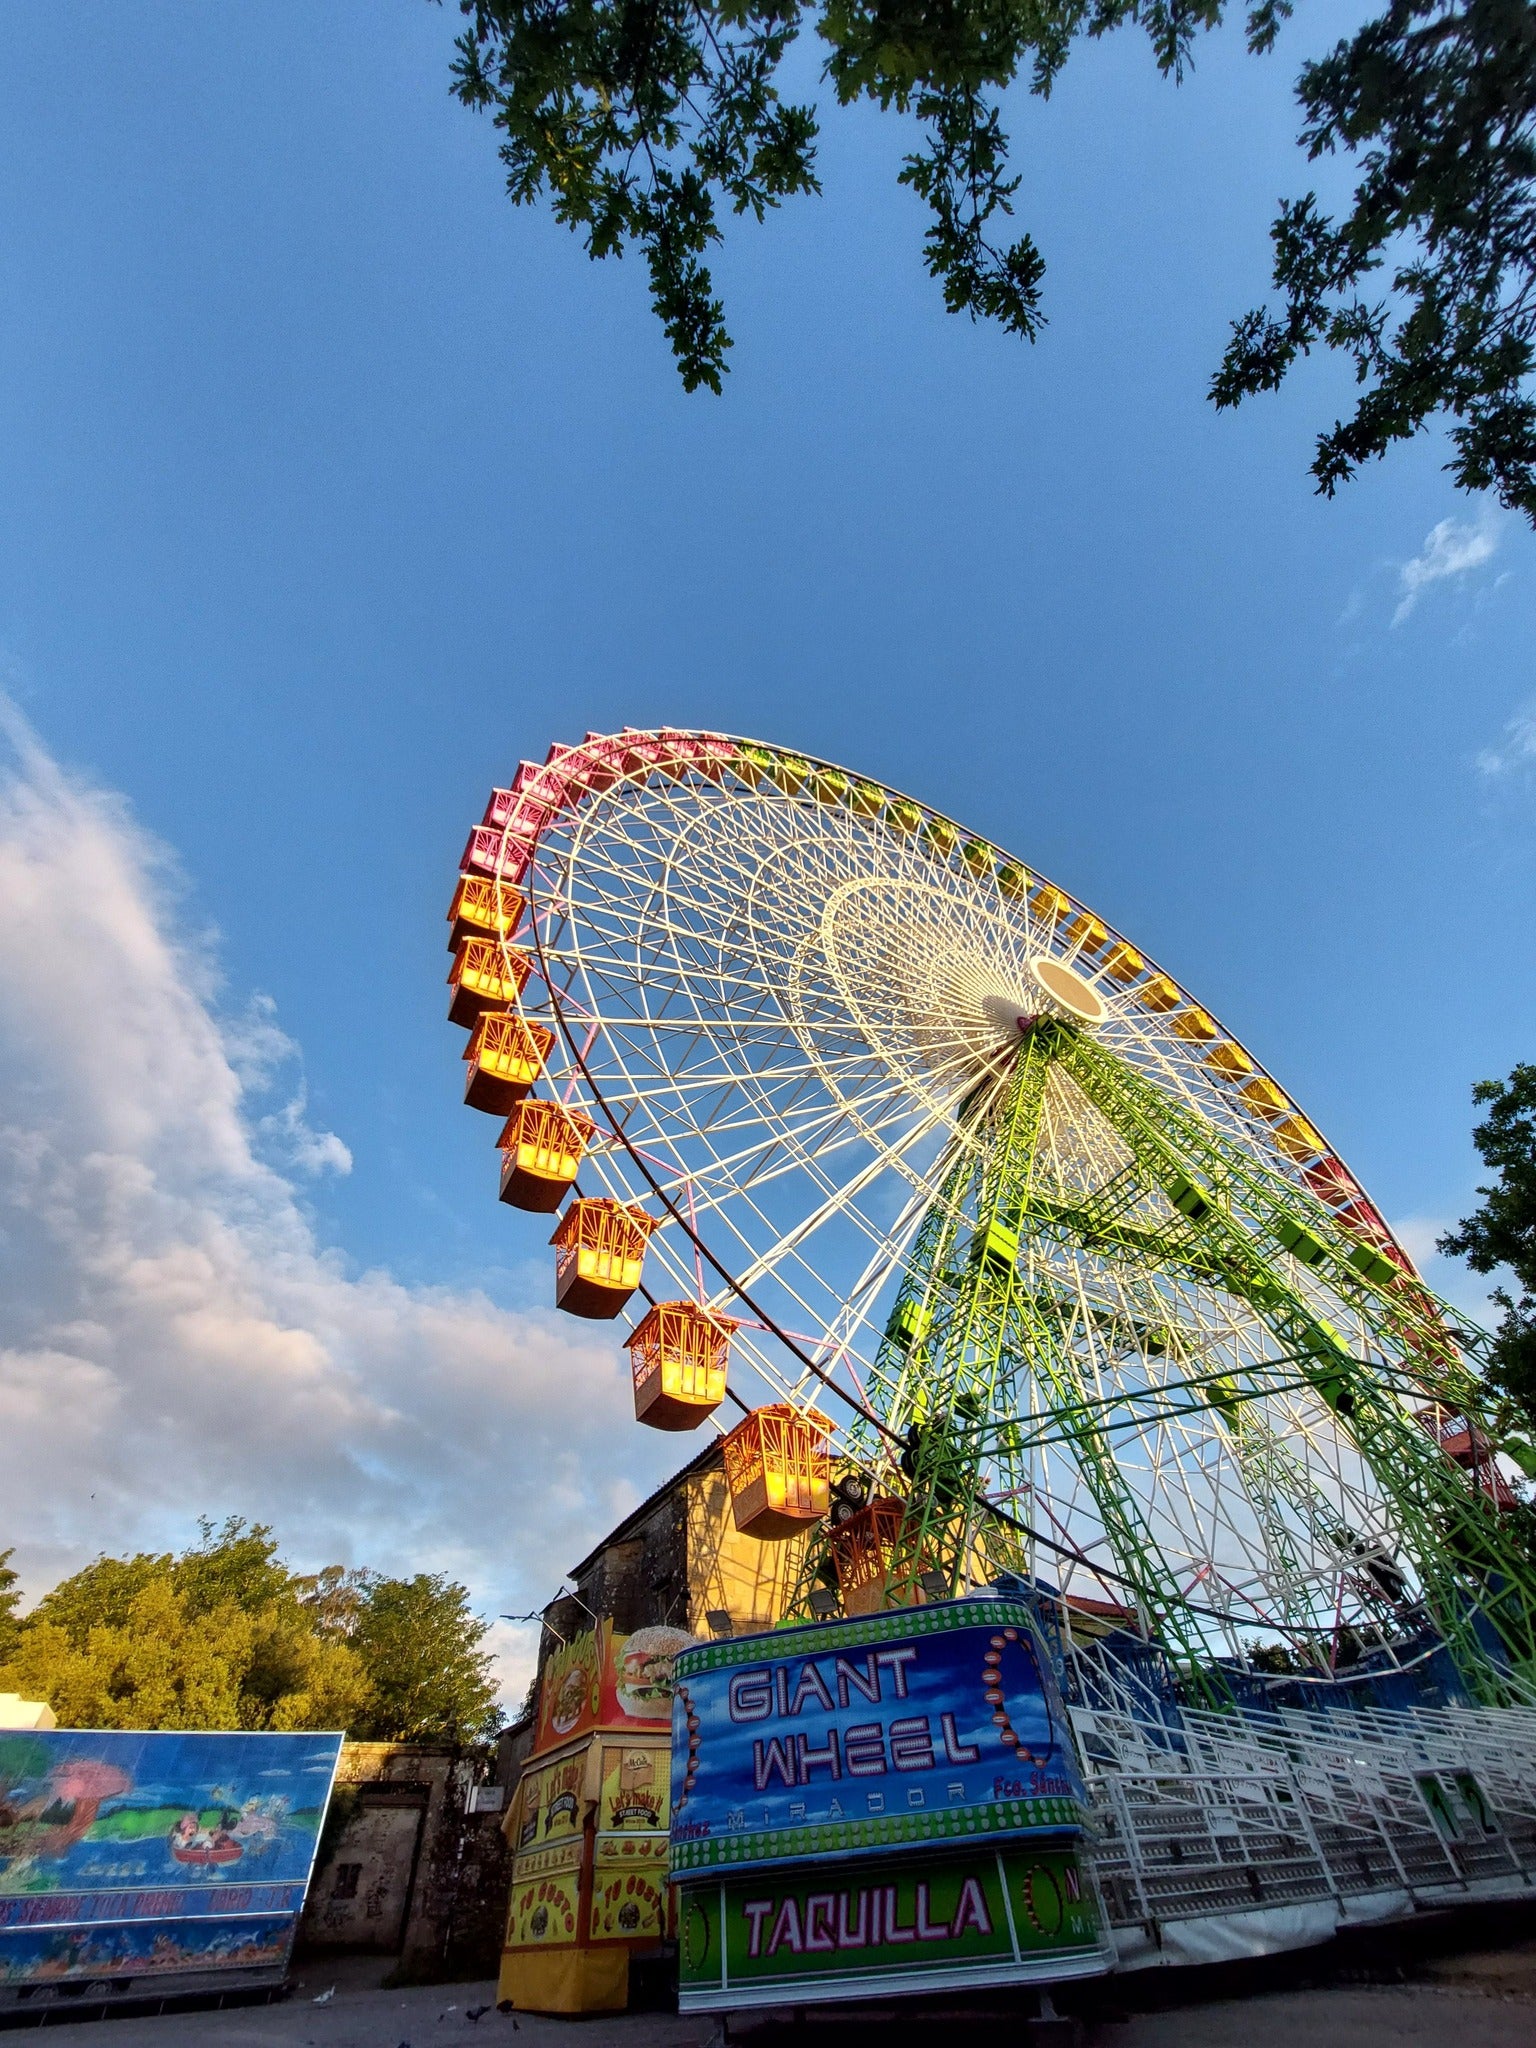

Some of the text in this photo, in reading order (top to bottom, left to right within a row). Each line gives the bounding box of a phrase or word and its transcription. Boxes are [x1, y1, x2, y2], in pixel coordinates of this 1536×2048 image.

[728, 1646, 918, 1723] GIANT
[752, 1713, 980, 1790] WHEEL
[632, 1789, 655, 1809] make
[743, 1877, 993, 1958] TAQUILLA
